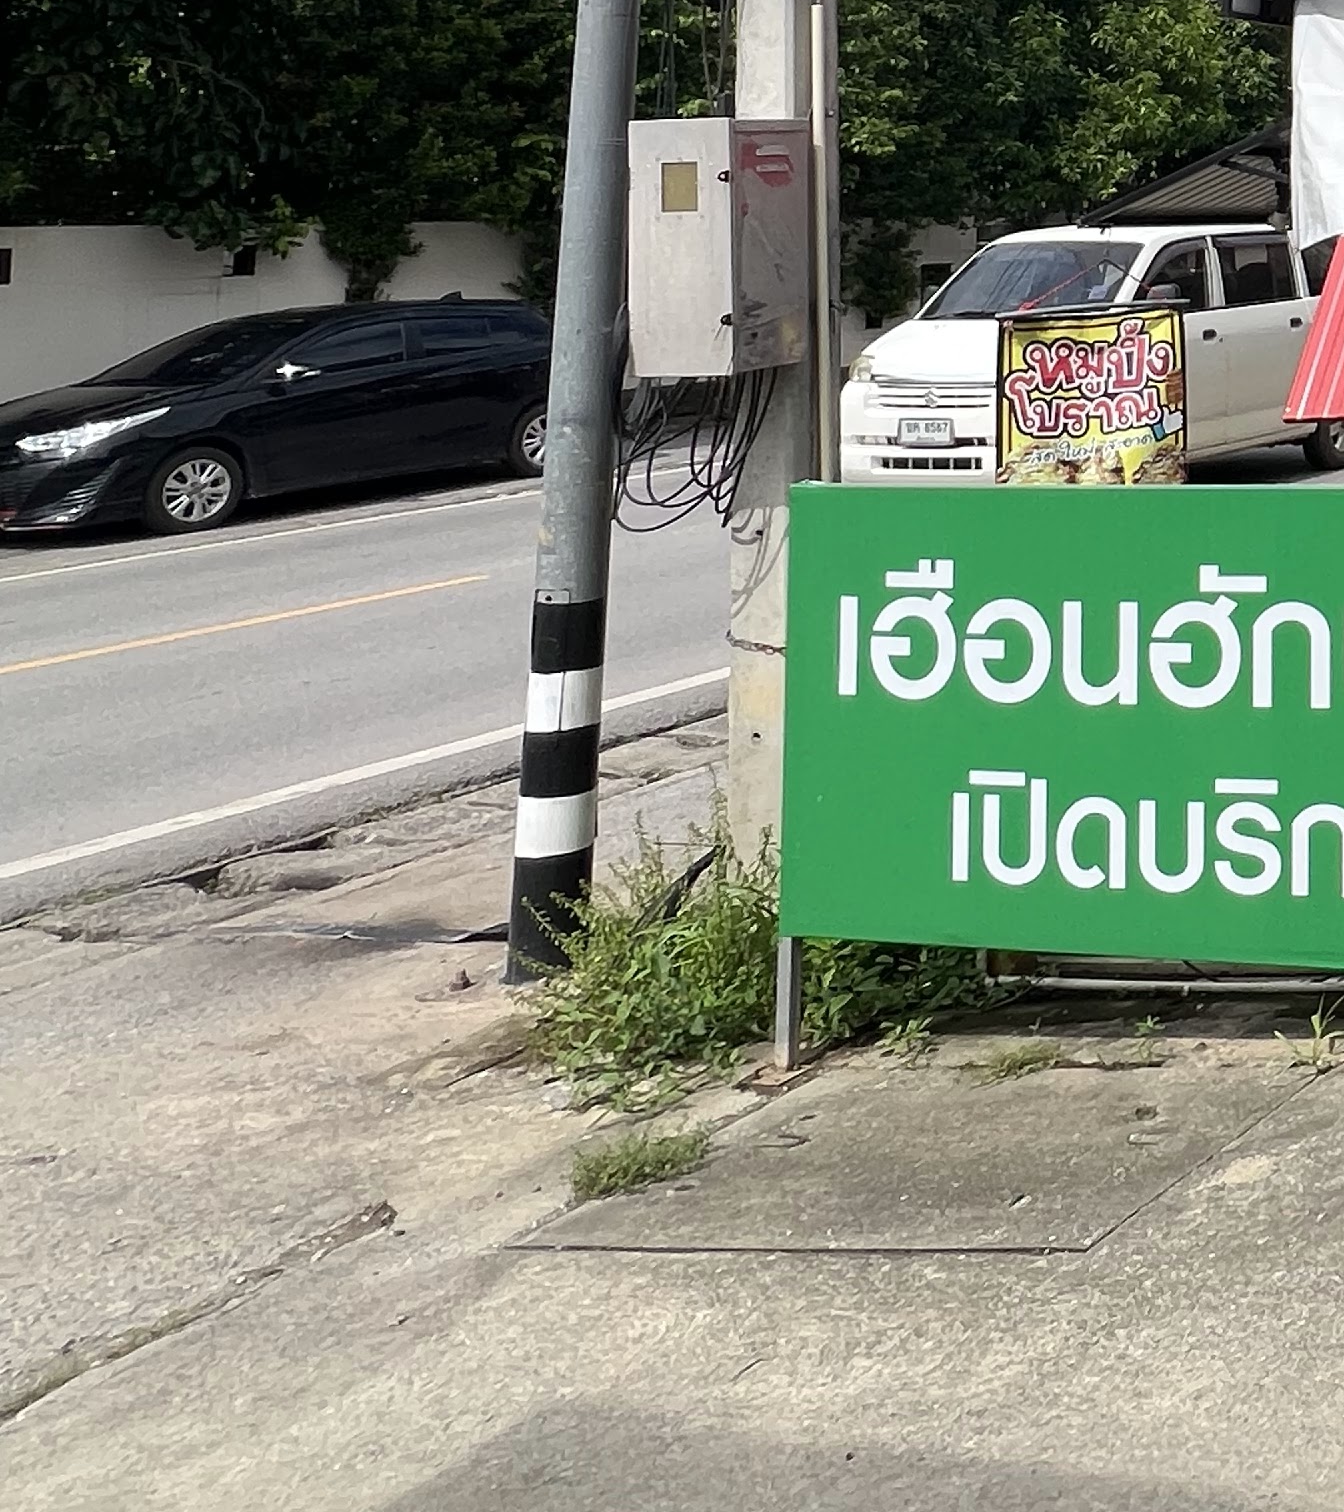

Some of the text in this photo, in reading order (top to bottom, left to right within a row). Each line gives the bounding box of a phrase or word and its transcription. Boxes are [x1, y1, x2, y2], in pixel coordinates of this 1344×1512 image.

[1026, 320, 1172, 396] หมูปิ้ง
[1006, 370, 1162, 435] โบราณ
